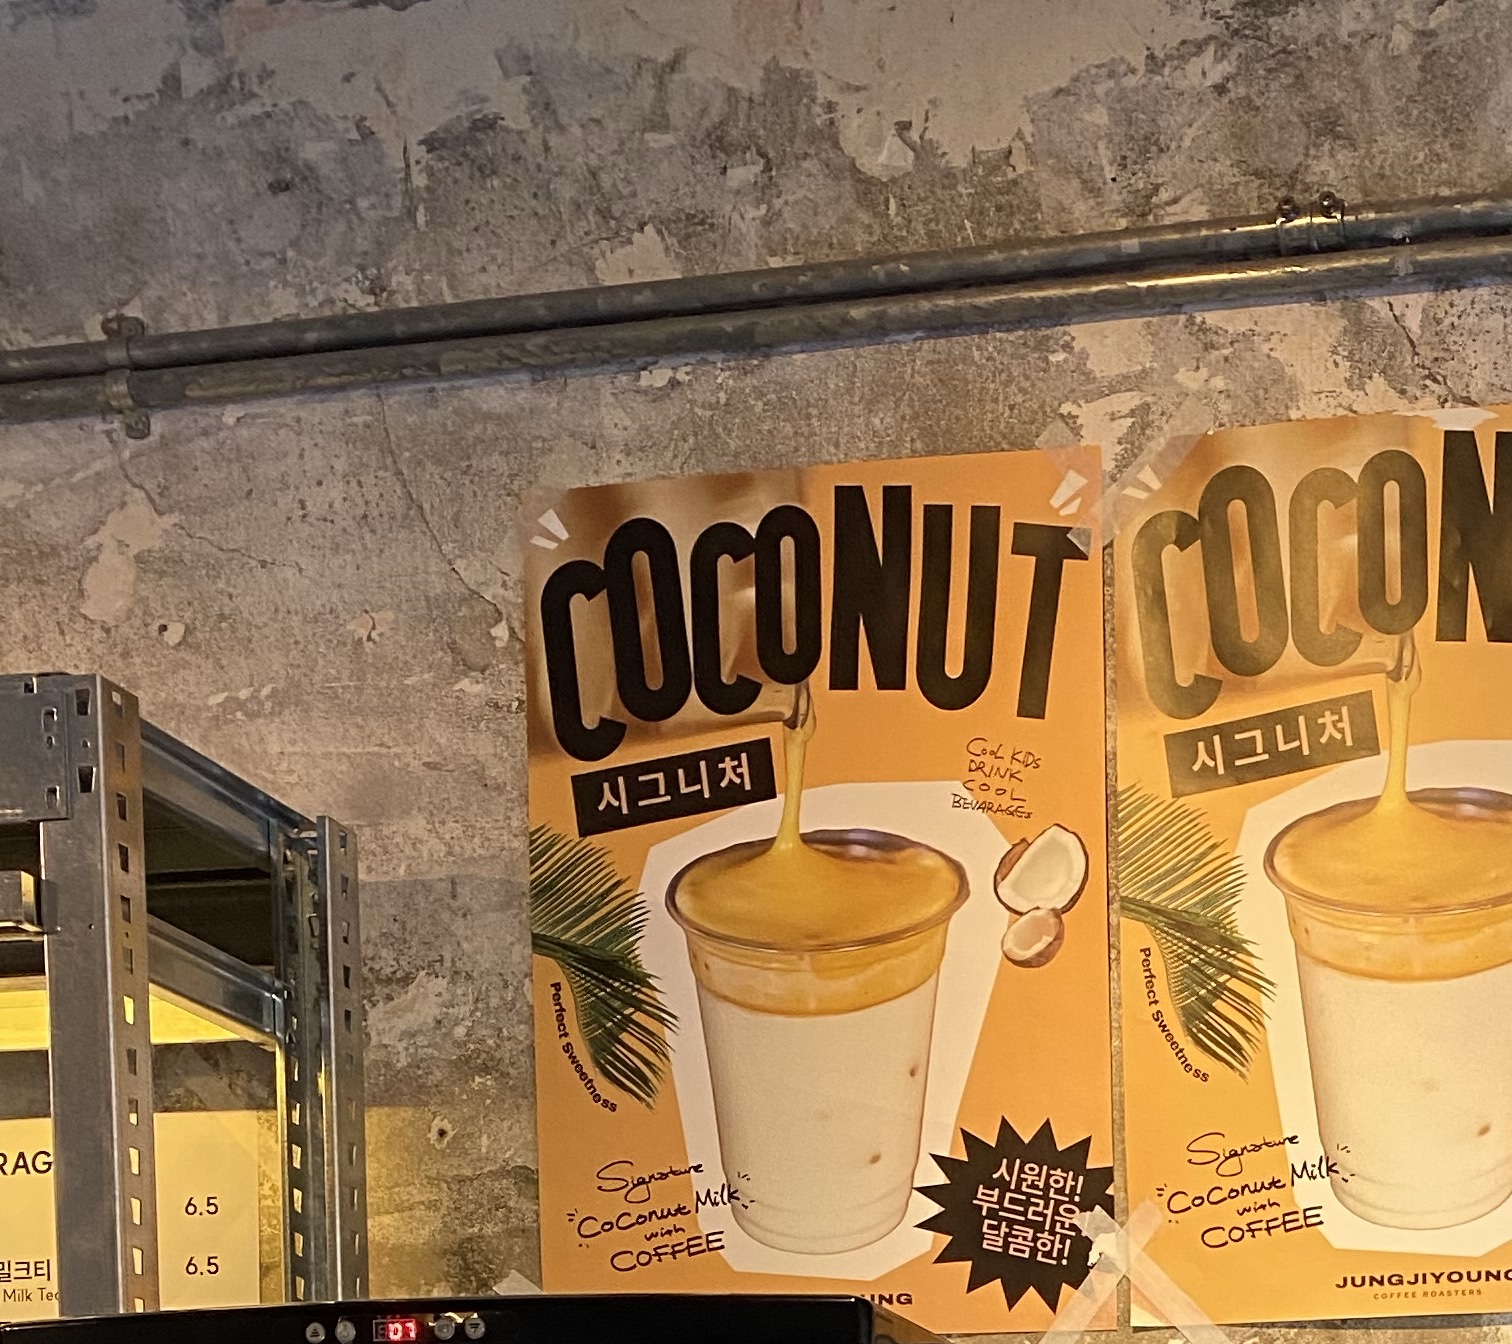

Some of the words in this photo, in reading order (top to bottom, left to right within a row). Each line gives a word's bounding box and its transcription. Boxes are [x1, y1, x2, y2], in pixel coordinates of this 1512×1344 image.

[541, 485, 1092, 762] COCONUT
[1192, 707, 1354, 776] 시그니처
[597, 750, 753, 817] 시그니처
[968, 758, 1025, 784] DRINK
[1139, 946, 1159, 1009] Perfect
[1151, 1009, 1211, 1084] Sweetness
[550, 981, 569, 1040] Perfect
[560, 1041, 618, 1114] Sweetness
[1186, 1132, 1300, 1177] Signature
[1290, 1161, 1341, 1188] Milk
[596, 1160, 704, 1203] Signature
[694, 1184, 741, 1213] Milk
[992, 1158, 1084, 1203] 시원한!
[185, 1196, 219, 1217] 6.5
[1201, 1206, 1324, 1250] COFFEE
[1235, 1198, 1280, 1218] with
[610, 1230, 725, 1273] COFFEE
[644, 1225, 686, 1242] with
[982, 1219, 1072, 1266] 달콤한!
[185, 1256, 219, 1277] 6.5
[3, 1288, 33, 1303] Milk
[1373, 1290, 1417, 1301] COFFEE
[1423, 1288, 1483, 1299] ROASTERS
